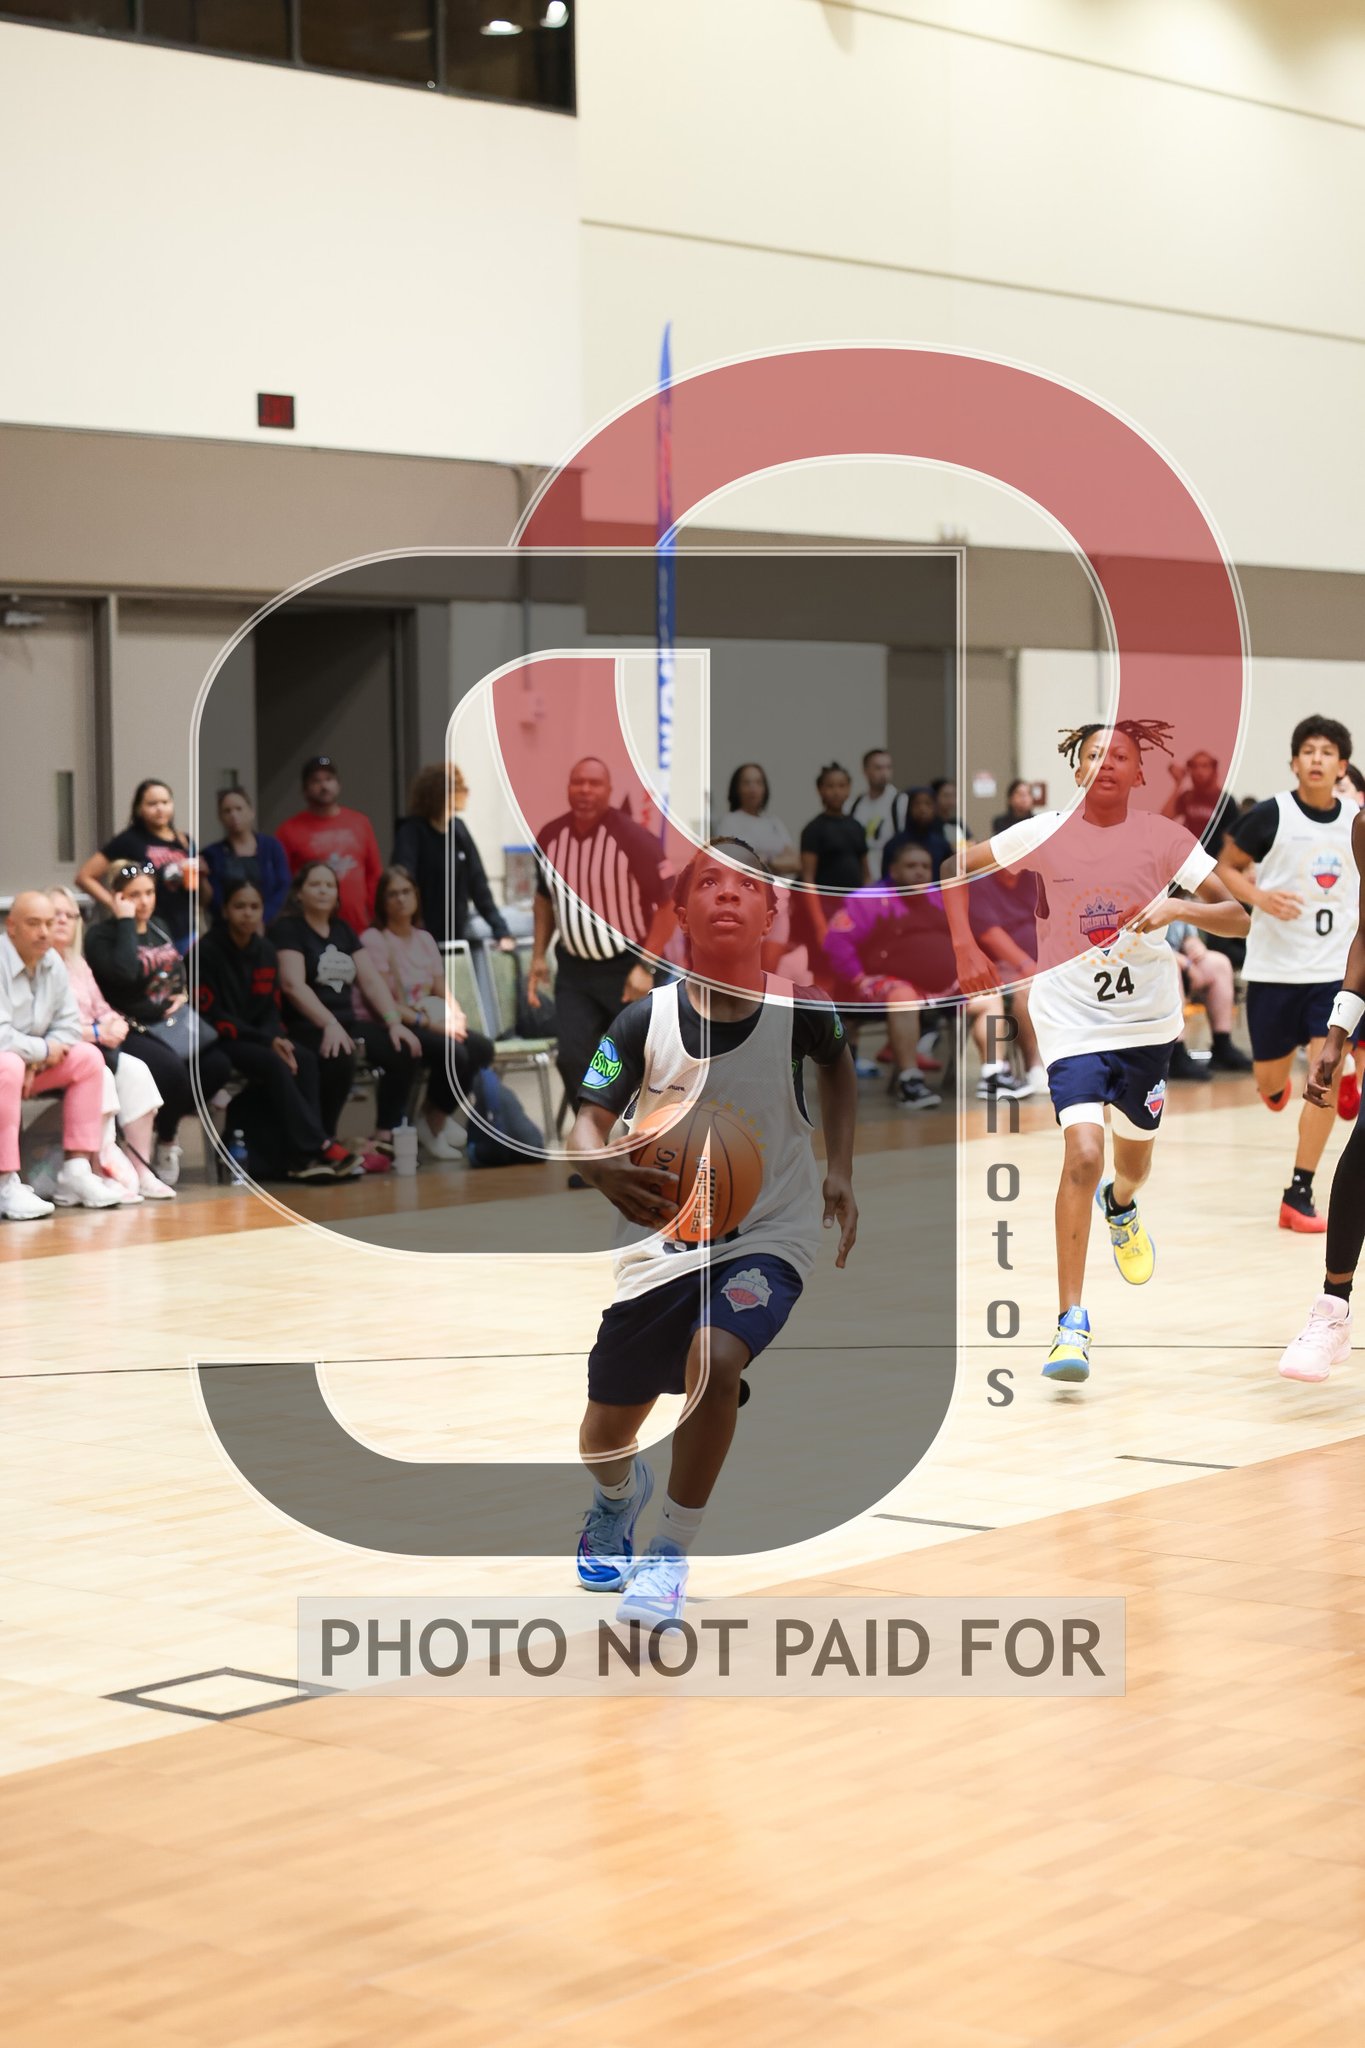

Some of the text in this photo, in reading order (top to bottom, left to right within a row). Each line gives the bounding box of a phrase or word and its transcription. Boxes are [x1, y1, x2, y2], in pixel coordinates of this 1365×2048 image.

[1316, 909, 1333, 936] 0
[1094, 966, 1135, 1002] 24
[690, 1154, 708, 1234] PRECISION
